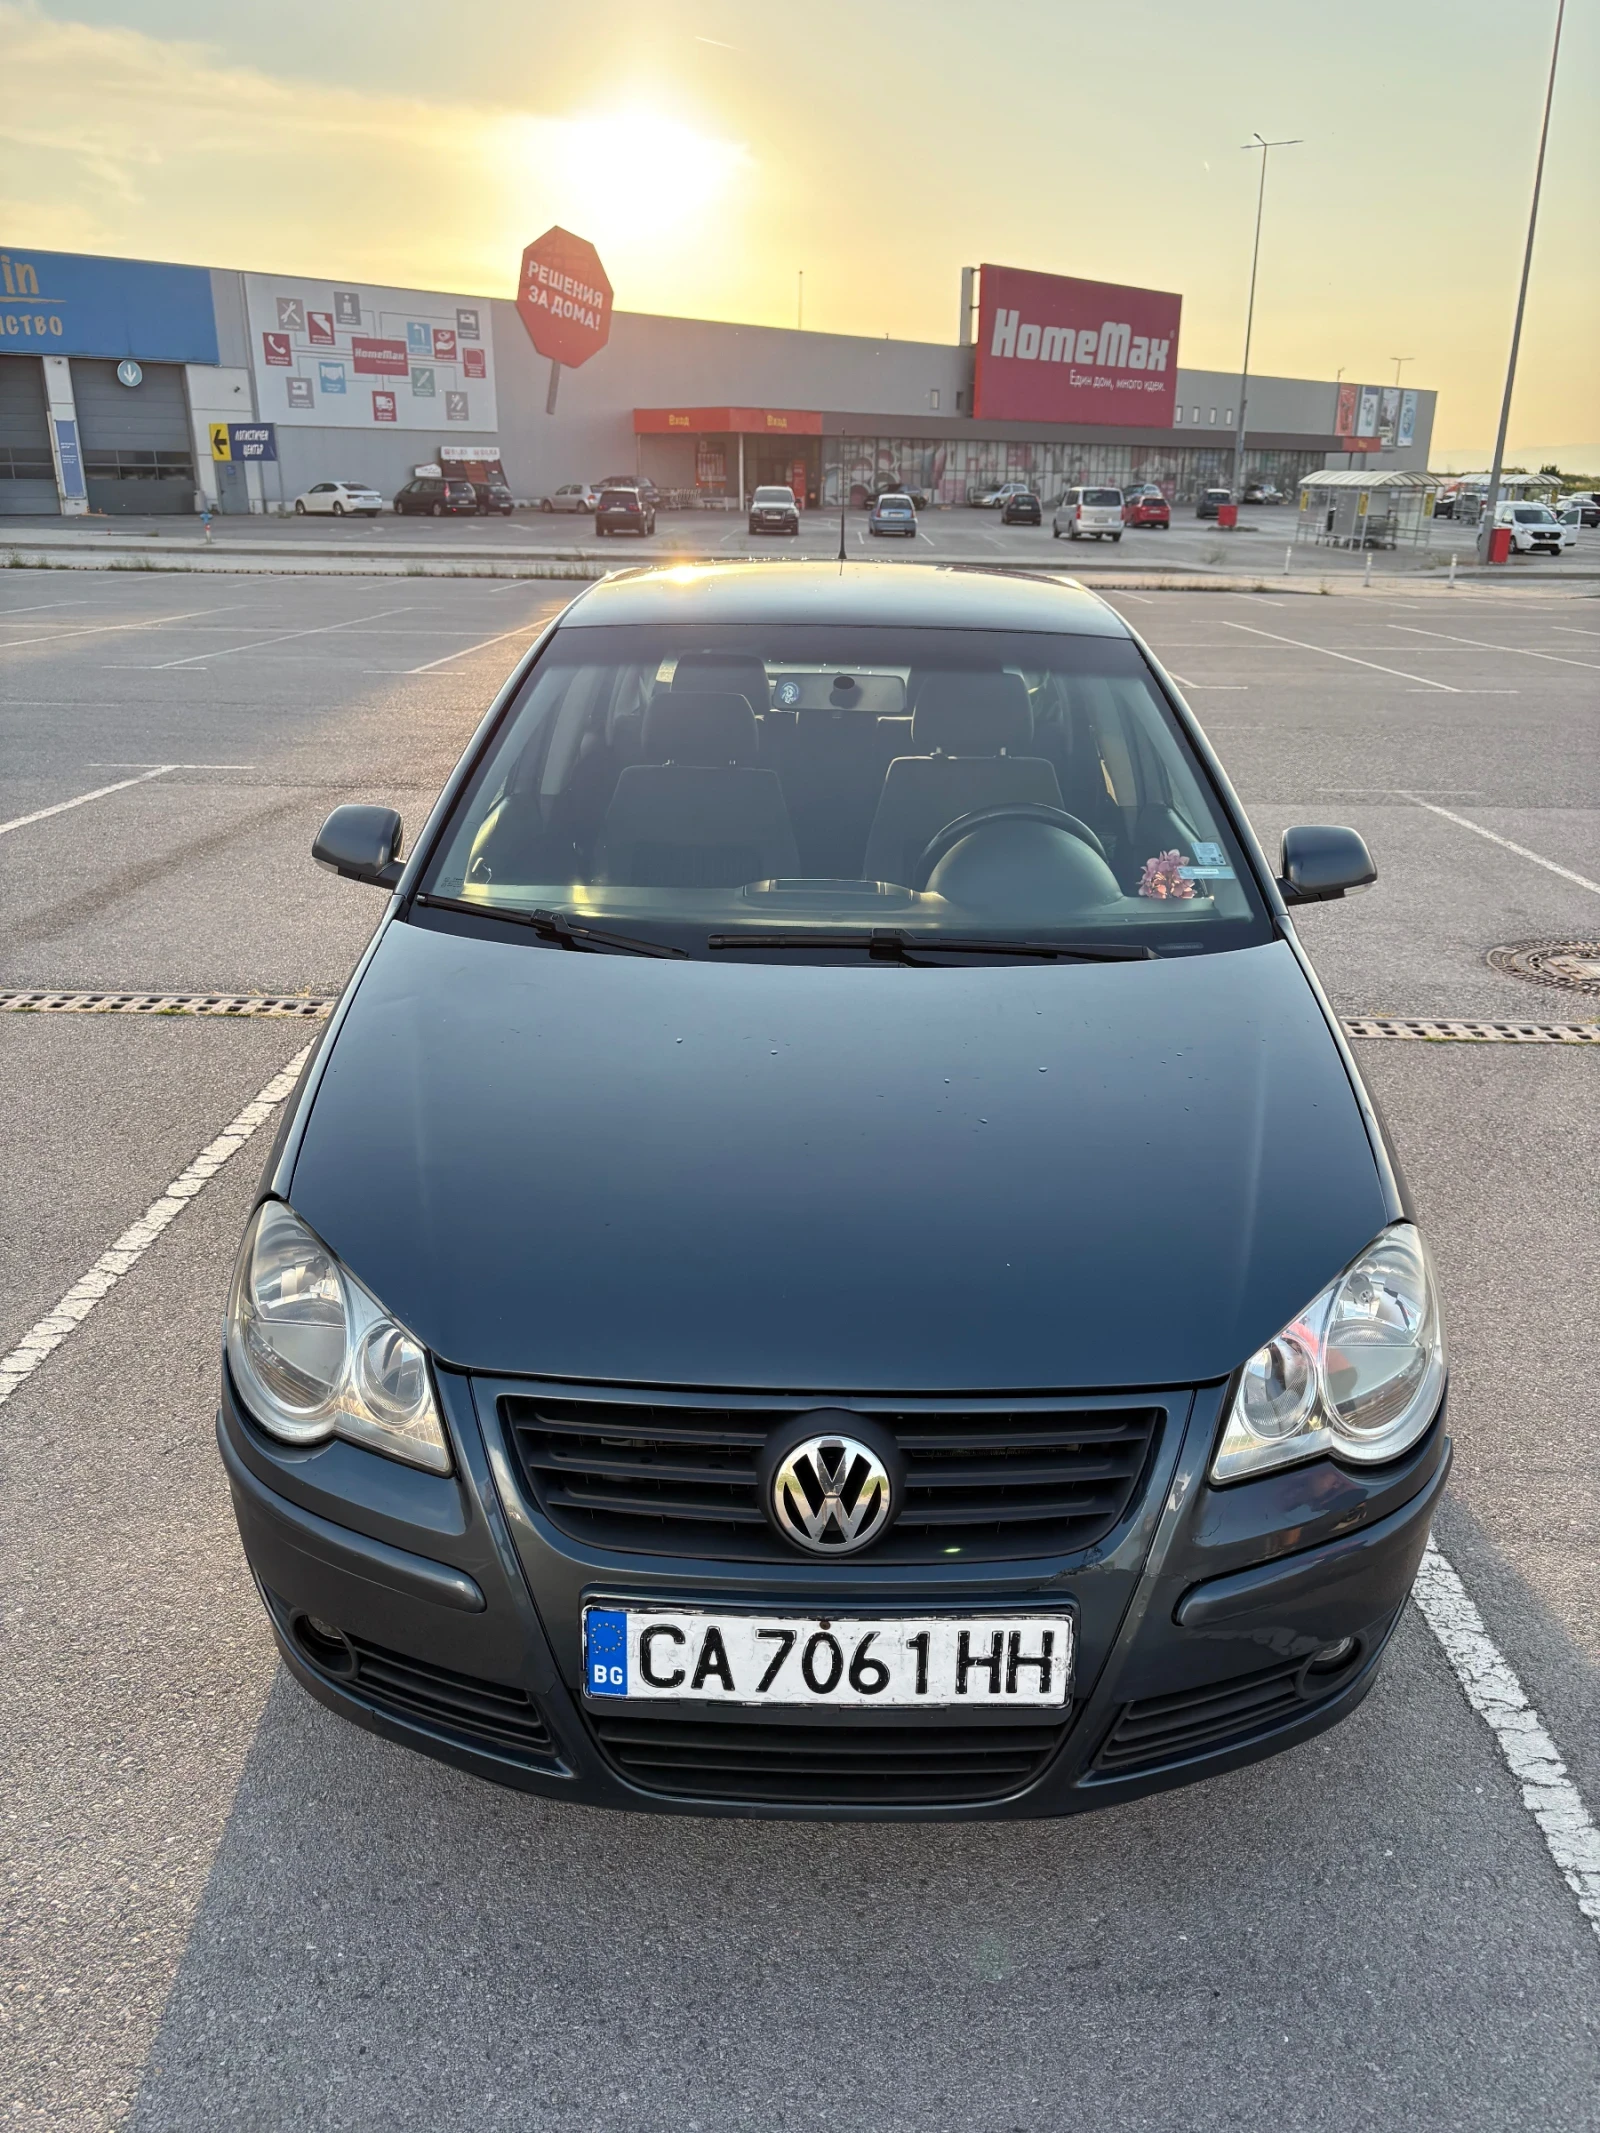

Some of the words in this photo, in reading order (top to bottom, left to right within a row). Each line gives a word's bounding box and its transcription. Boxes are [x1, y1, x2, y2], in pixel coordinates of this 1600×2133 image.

[527, 260, 604, 309] РЕШЕНИЯ
[528, 285, 548, 309] ЗА
[550, 295, 601, 331] ДОМА!
[0, 314, 63, 336] СТВО
[991, 308, 1170, 371] HomeMax
[1069, 369, 1092, 388] Един
[1093, 376, 1114, 391] дом,
[1116, 379, 1143, 390] много
[668, 414, 690, 427] Вход
[766, 414, 788, 428] Вход
[754, 1628, 931, 1696] 7061
[593, 1663, 624, 1686] BG
